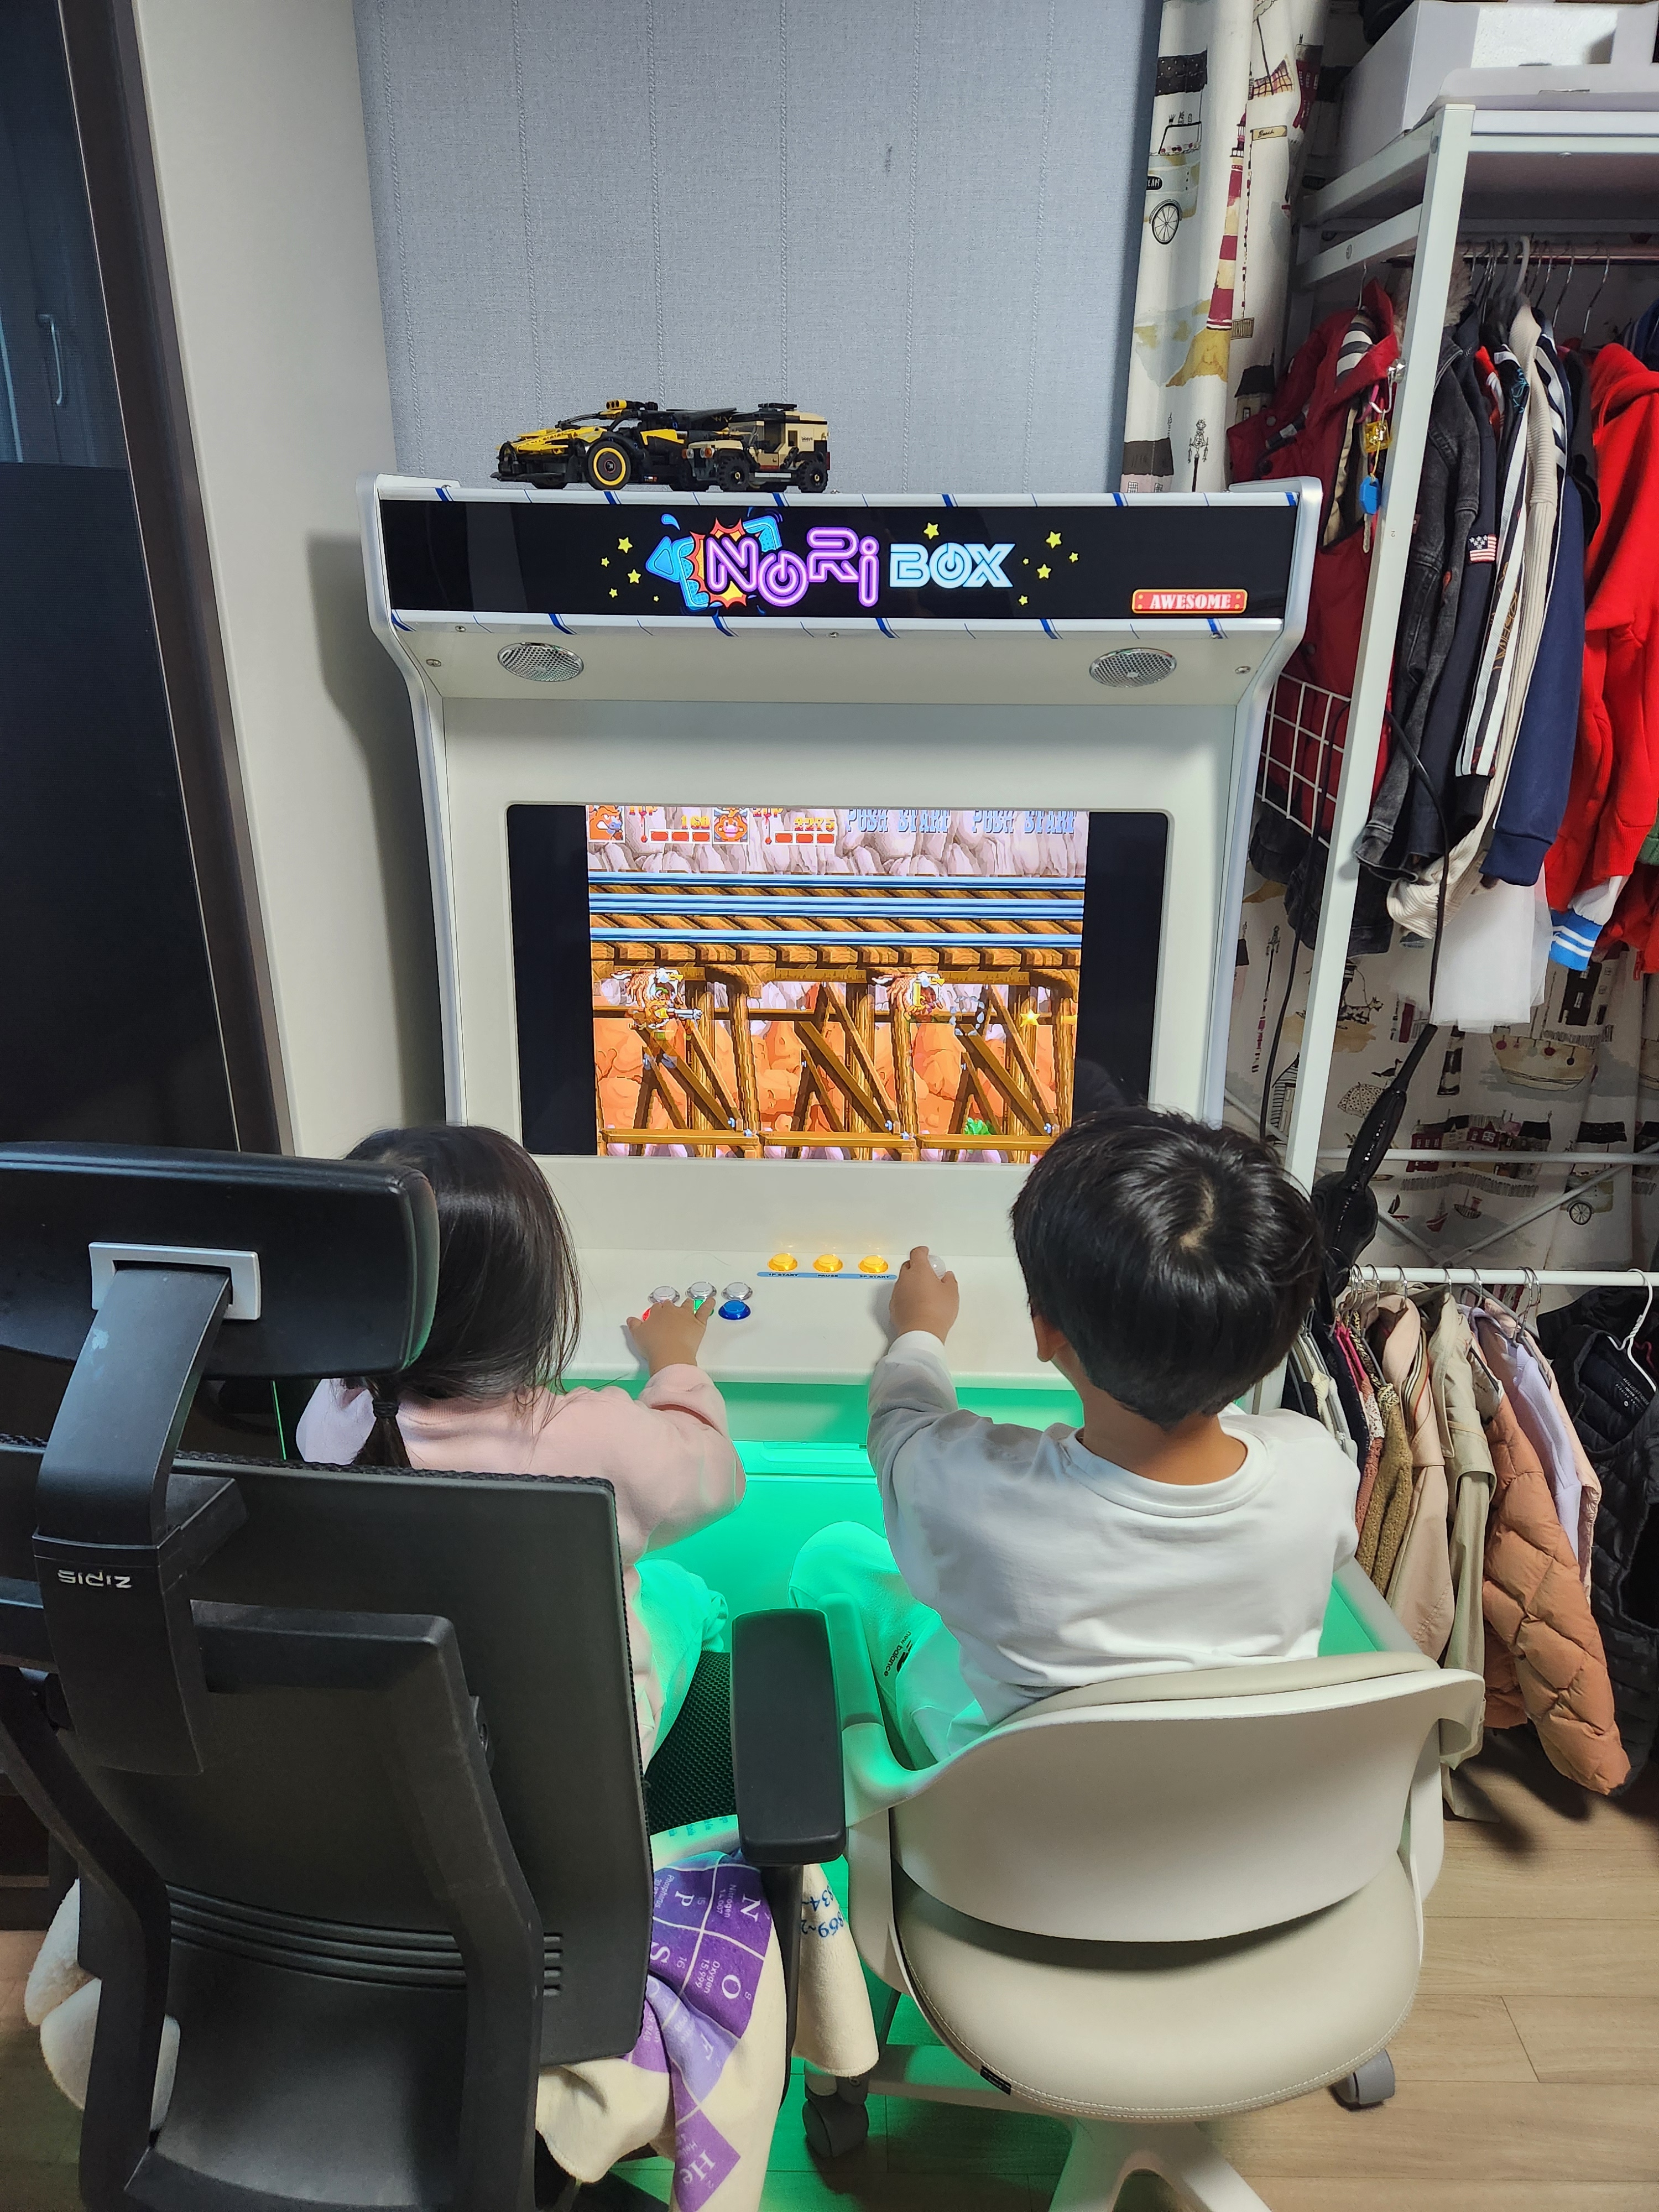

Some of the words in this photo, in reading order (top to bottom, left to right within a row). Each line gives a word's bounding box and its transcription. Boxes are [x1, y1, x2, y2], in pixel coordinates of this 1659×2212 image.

[890, 542, 1016, 588] BOX
[1149, 593, 1232, 609] AWESOME
[847, 808, 889, 832] PUSH
[898, 809, 950, 833] START
[972, 810, 1015, 833] PUSH
[1024, 811, 1077, 834] START
[900, 1630, 912, 1645] new
[884, 1645, 903, 1677] balance
[675, 1890, 695, 1907] P
[724, 1884, 737, 1918] Nitrogen
[740, 1893, 761, 1922] N
[650, 1942, 670, 1964] S
[695, 1958, 711, 1989] 15.999
[703, 1960, 721, 1994] Oxygen
[722, 1974, 742, 2000] O
[744, 1991, 753, 2000] 8
[680, 2148, 716, 2185] He
